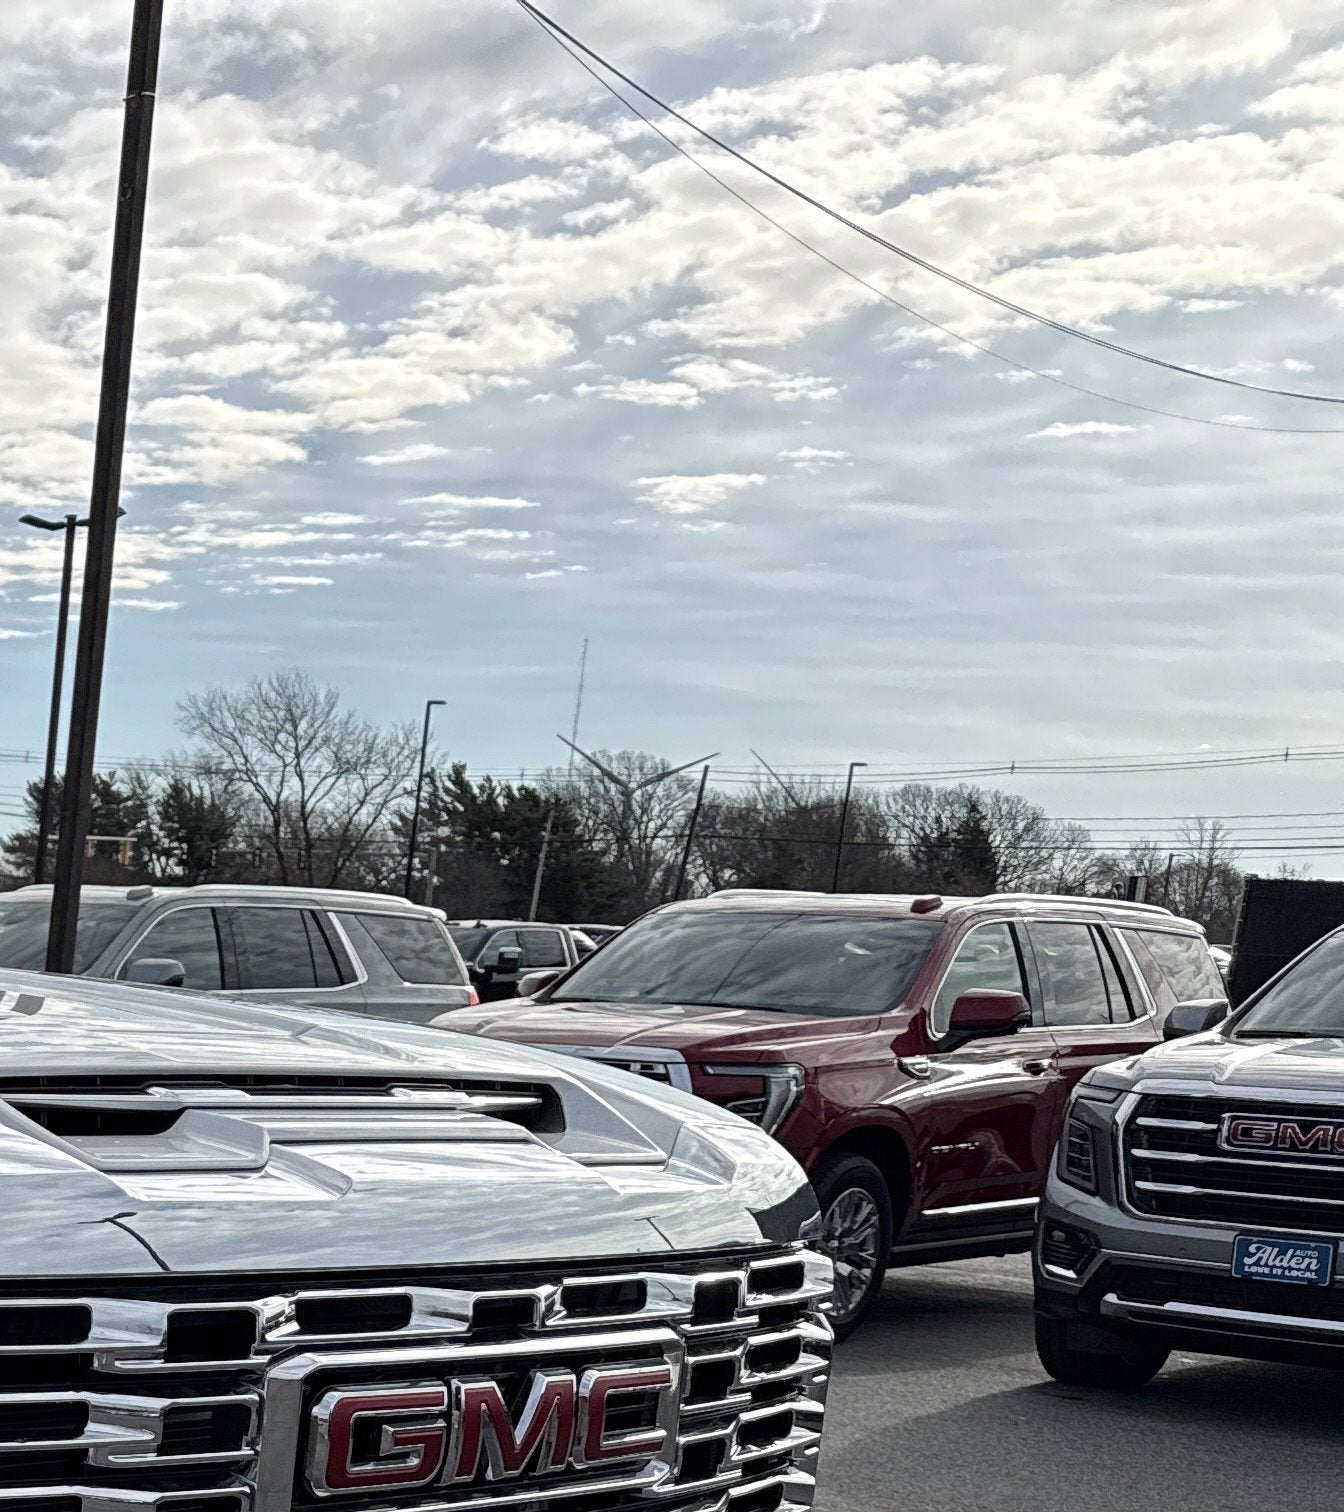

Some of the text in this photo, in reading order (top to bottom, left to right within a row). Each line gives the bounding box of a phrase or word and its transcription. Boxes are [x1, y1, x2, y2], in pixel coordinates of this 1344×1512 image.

[1230, 1120, 1344, 1152] GM
[1243, 1243, 1321, 1271] Alden
[1293, 1249, 1319, 1259] AUTO
[1244, 1265, 1319, 1280] LOVE IT LOCAL
[311, 1360, 672, 1497] GMC
